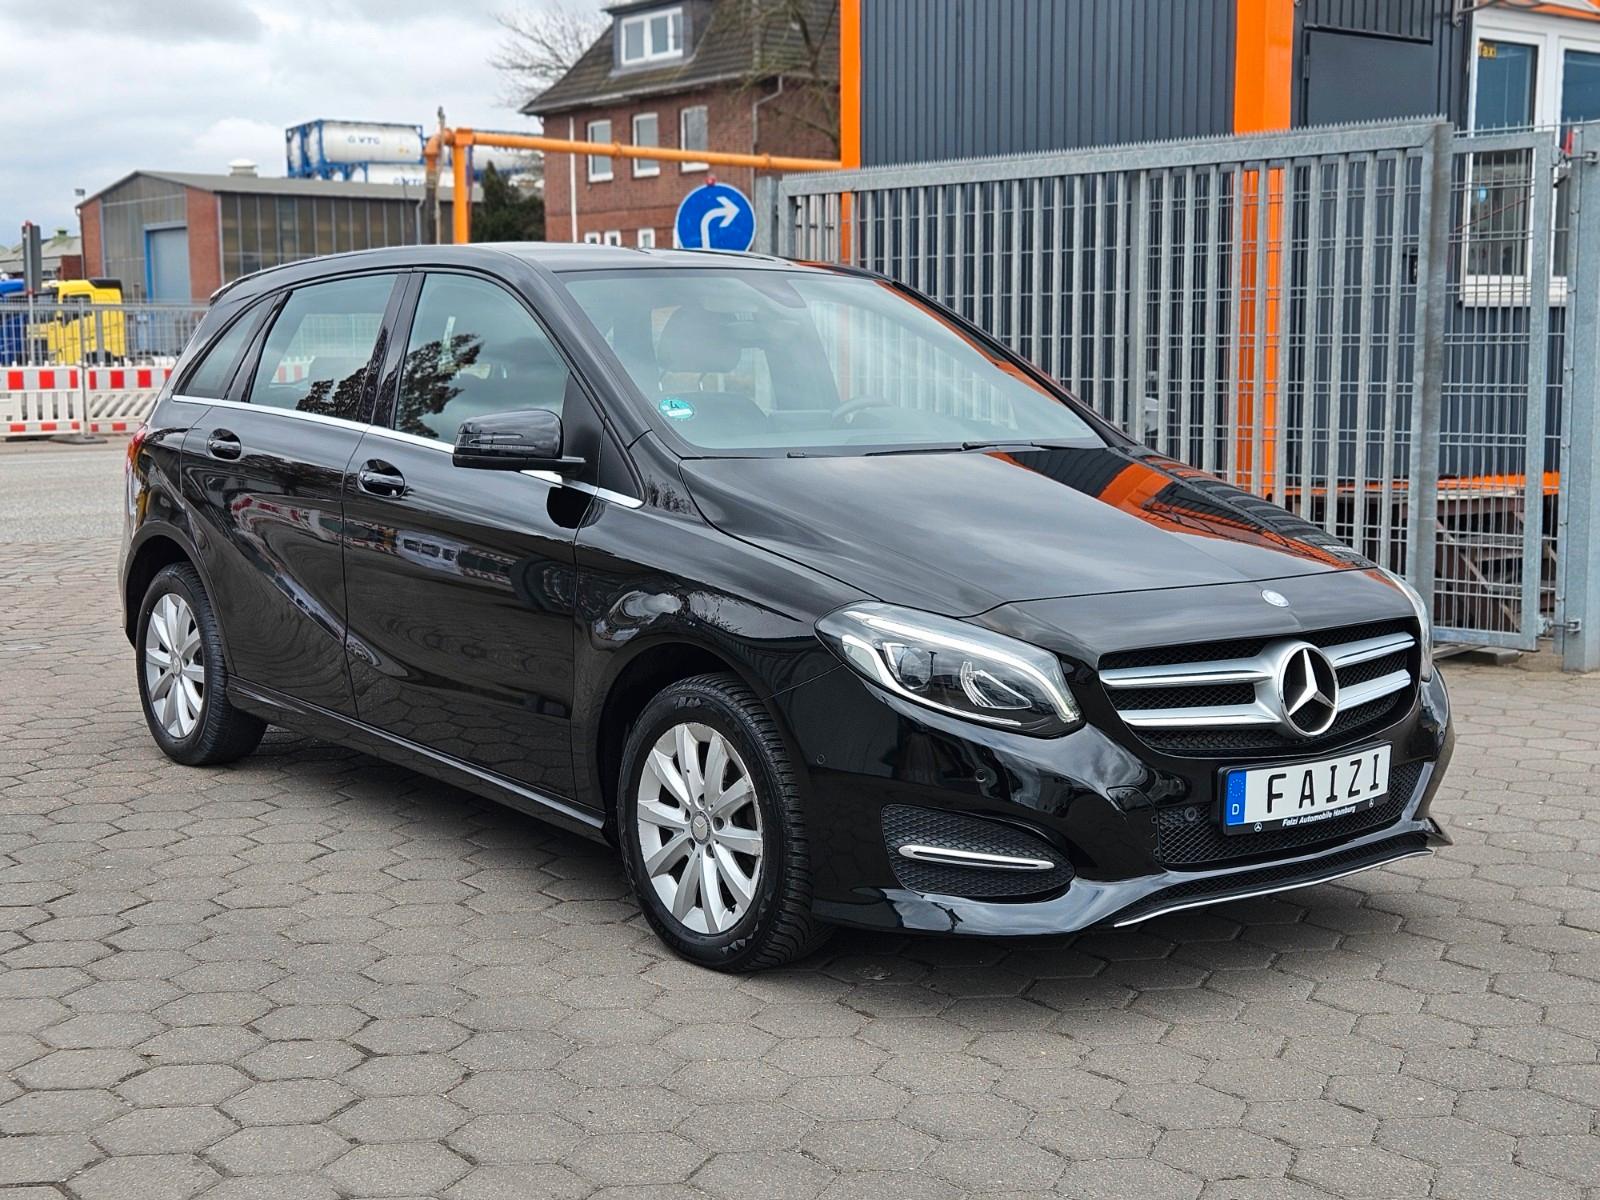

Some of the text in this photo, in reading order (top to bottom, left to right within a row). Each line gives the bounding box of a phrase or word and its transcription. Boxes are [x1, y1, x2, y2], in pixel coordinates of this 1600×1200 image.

[1266, 753, 1380, 814] FAIZI
[1231, 803, 1240, 815] D
[1282, 816, 1299, 827] Faizi
[1299, 810, 1333, 825] Automobile
